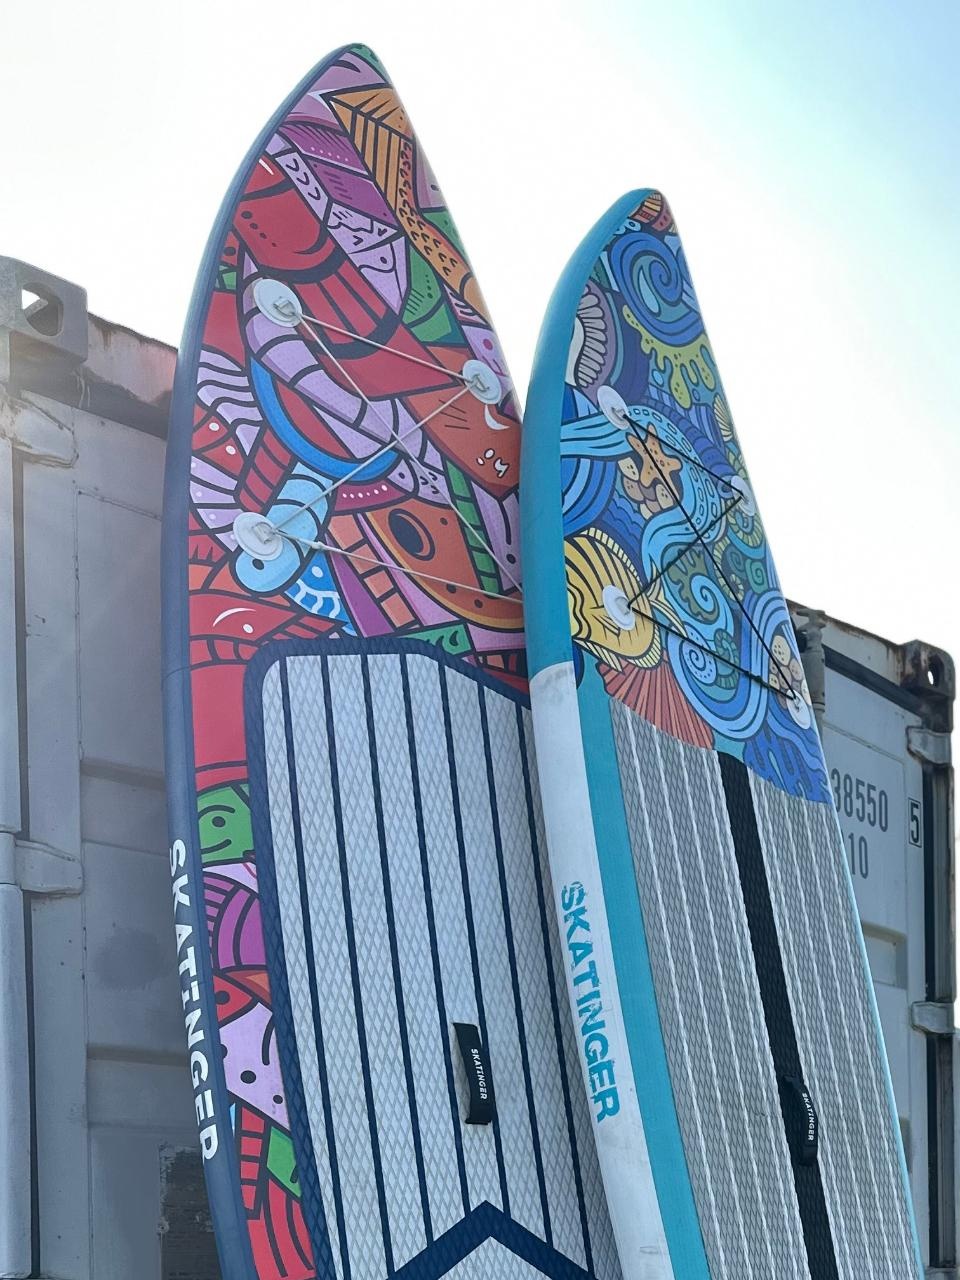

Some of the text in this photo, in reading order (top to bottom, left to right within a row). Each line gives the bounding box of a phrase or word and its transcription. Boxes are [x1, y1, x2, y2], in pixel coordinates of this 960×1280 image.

[831, 768, 919, 844] 38550 5
[841, 829, 868, 879] 10
[169, 839, 218, 1165] SKATINGER
[561, 881, 621, 1123] SKATINGER
[470, 1048, 488, 1100] SKATINGER
